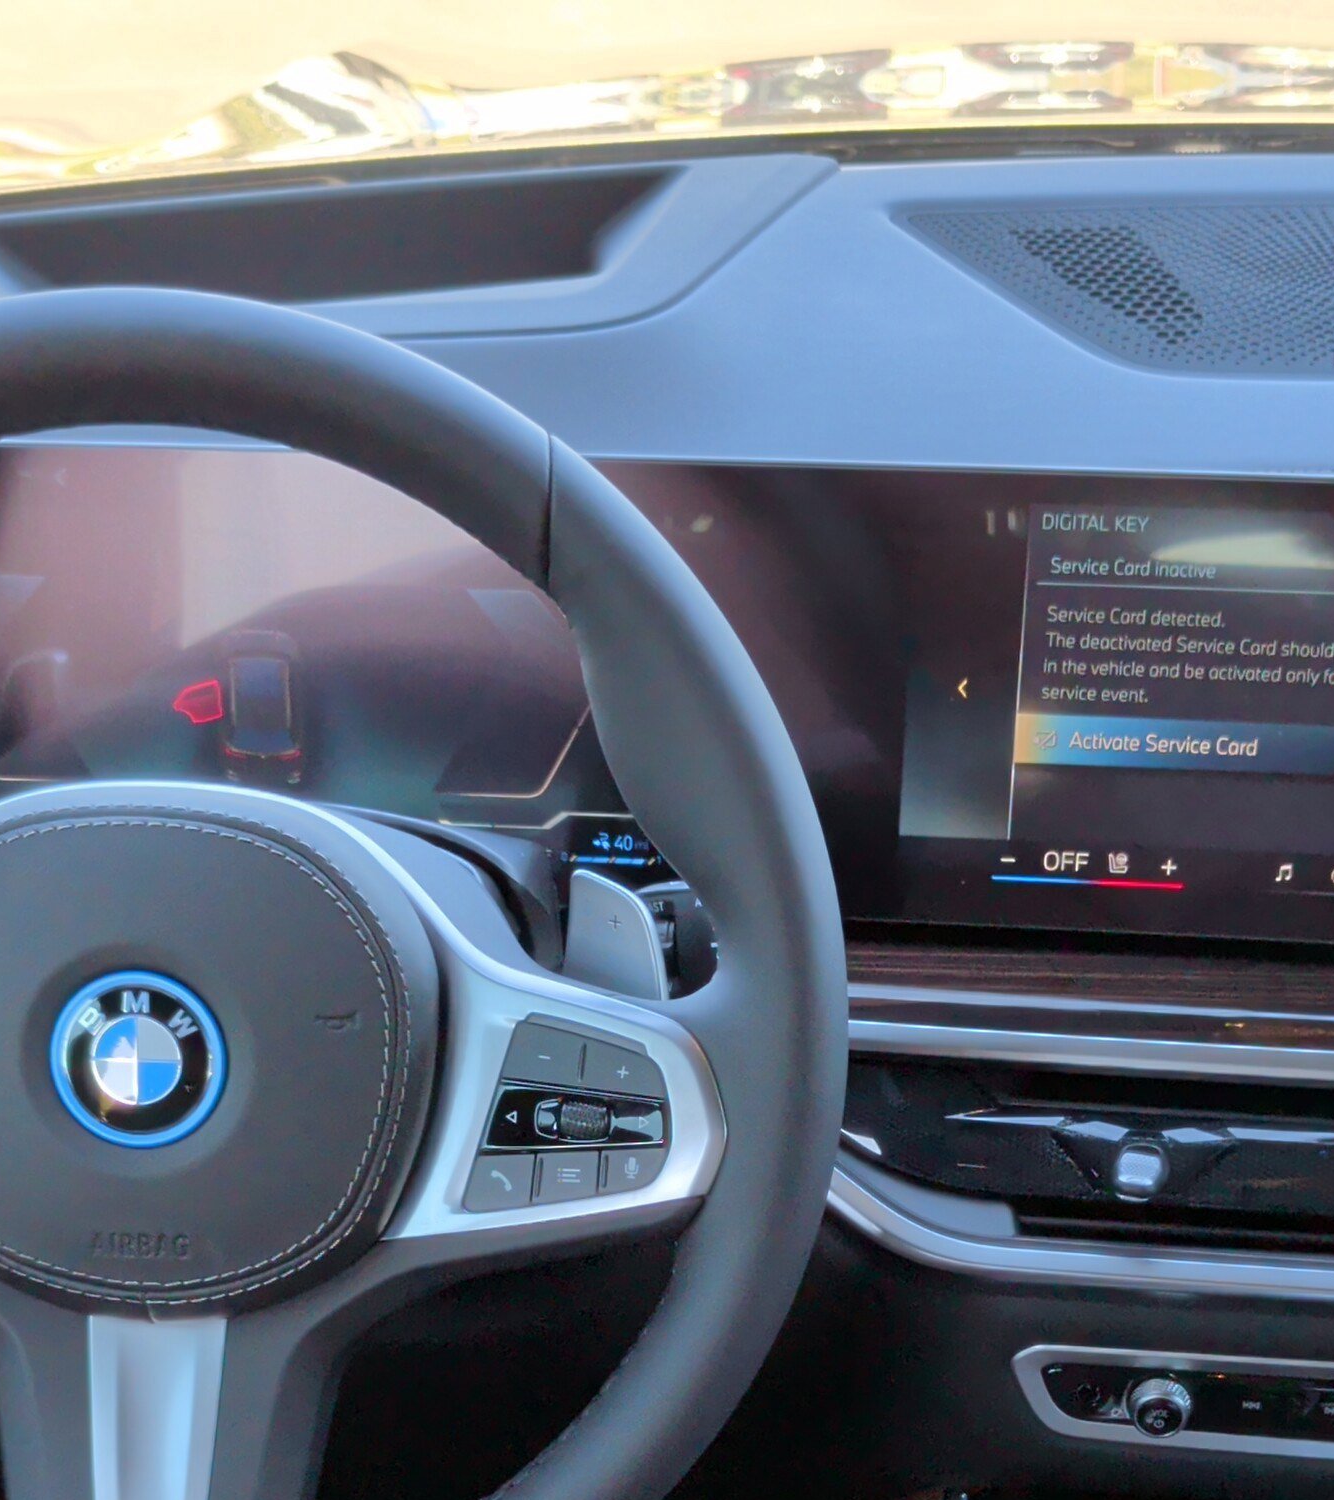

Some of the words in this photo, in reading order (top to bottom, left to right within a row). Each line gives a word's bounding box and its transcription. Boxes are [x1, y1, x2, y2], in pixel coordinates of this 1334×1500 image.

[1042, 513, 1109, 532] DIGITAL
[1114, 515, 1149, 533] KEY
[1050, 556, 1108, 576] Service
[1114, 559, 1150, 577] Card
[1155, 560, 1216, 580] inactive
[1047, 606, 1105, 625] Service
[1110, 608, 1146, 625] Card
[1151, 609, 1226, 628] detected.
[1046, 633, 1075, 649] The
[1079, 634, 1171, 653] deactivated
[1176, 636, 1234, 655] Service
[1240, 639, 1276, 657] Card
[1281, 640, 1333, 659] should
[1043, 659, 1057, 674] in
[1061, 659, 1085, 676] the
[1090, 660, 1145, 678] vehicle
[1149, 663, 1180, 679] and
[1184, 663, 1204, 680] be
[1208, 665, 1280, 683] activated
[1286, 668, 1319, 687] only
[1041, 686, 1097, 701] service
[1101, 688, 1148, 704] event.
[1069, 732, 1140, 753] Activate
[1145, 734, 1211, 755] Service
[1216, 737, 1257, 757] Card
[613, 834, 634, 851] 40
[1043, 852, 1089, 873] OFF
[78, 989, 199, 1039] BMW
[90, 1230, 192, 1261] AIRBAG
